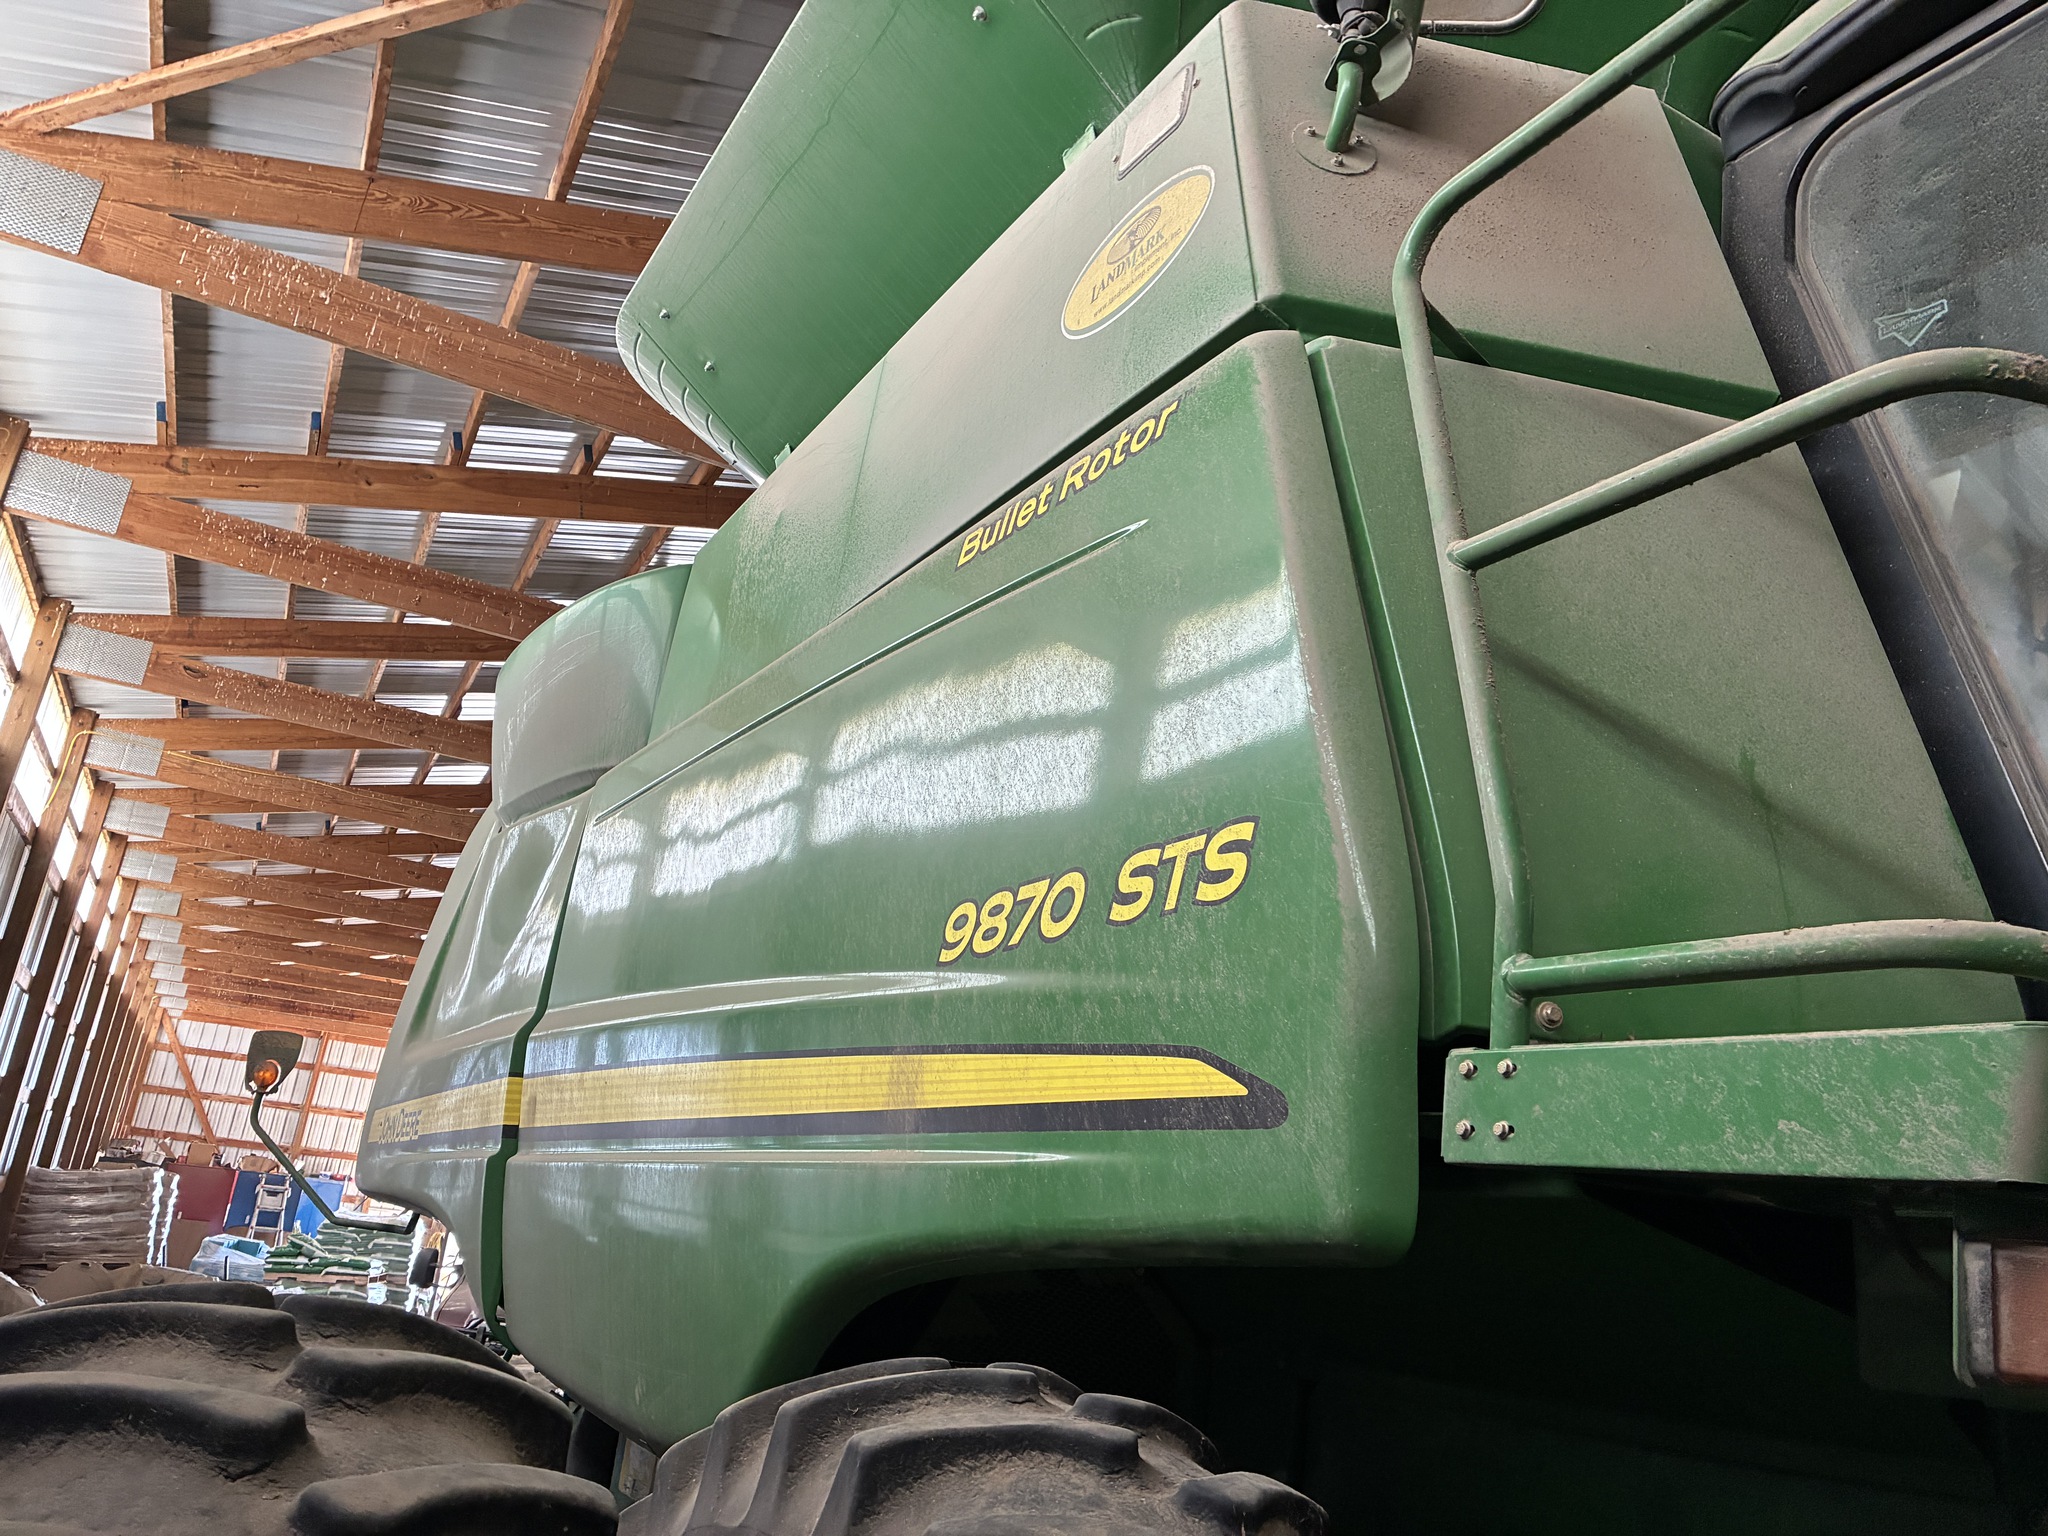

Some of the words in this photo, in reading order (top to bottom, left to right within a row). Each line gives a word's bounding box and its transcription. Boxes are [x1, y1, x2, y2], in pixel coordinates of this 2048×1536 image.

[1090, 225, 1166, 304] LANDMARK
[955, 480, 1057, 573] Bullet
[1055, 395, 1182, 507] Rotor
[936, 867, 1089, 967] 9870
[1105, 815, 1261, 927] STS
[378, 1112, 402, 1144] JOHN
[395, 1109, 422, 1141] DEERE
